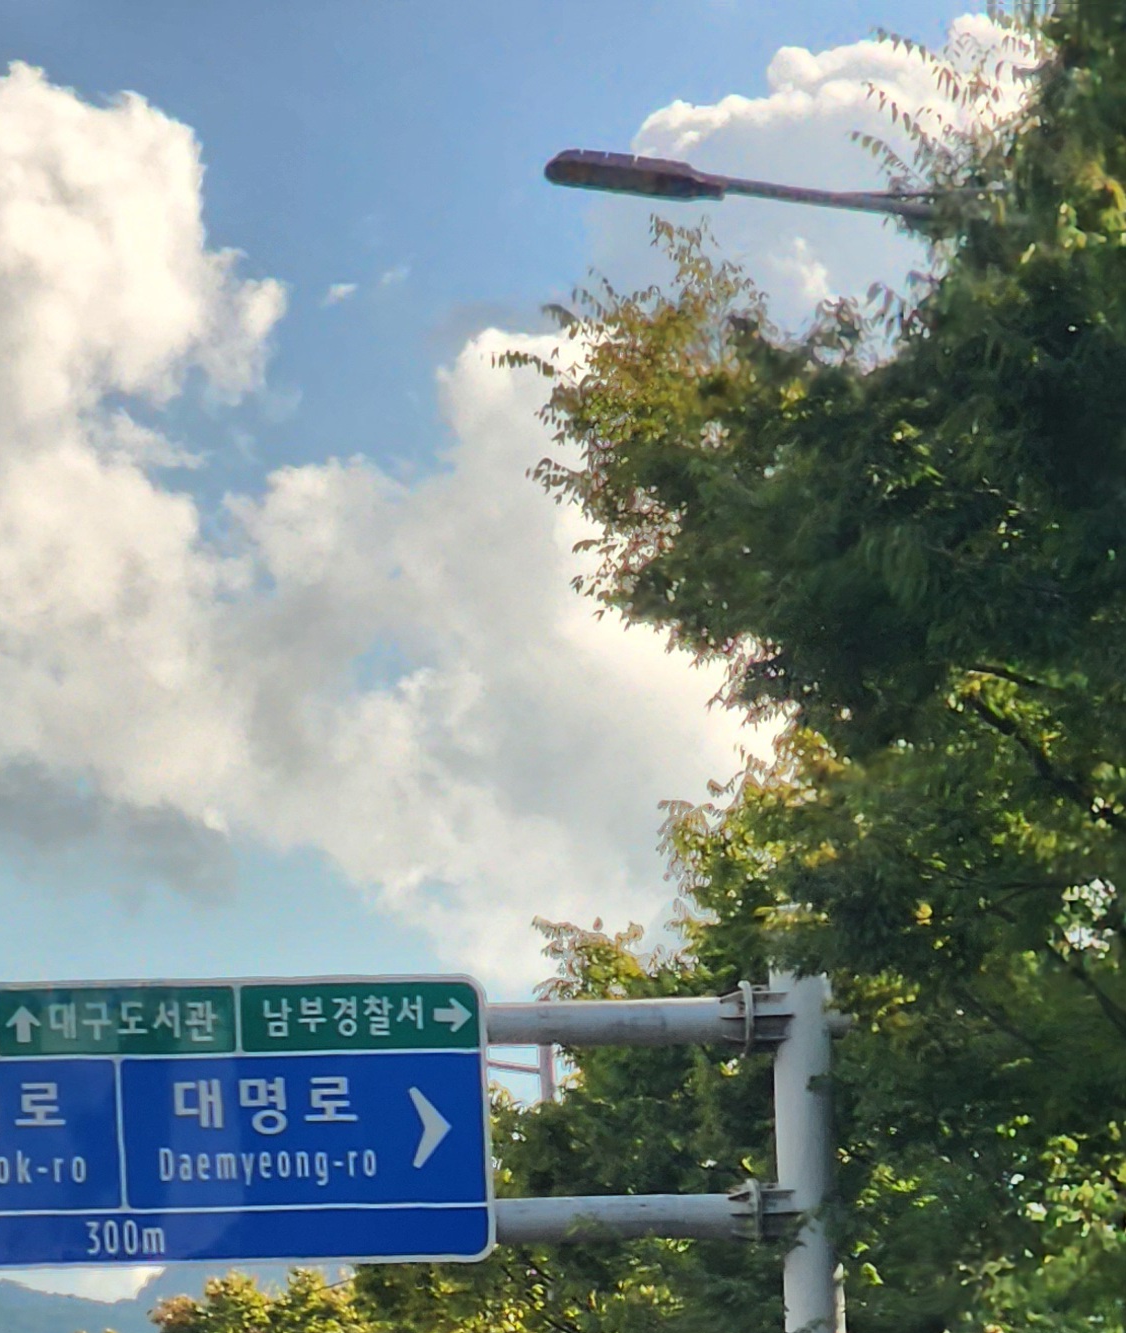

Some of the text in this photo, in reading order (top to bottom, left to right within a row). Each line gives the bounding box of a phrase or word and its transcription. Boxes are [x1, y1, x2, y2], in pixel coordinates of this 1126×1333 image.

[48, 1001, 218, 1042] 대구도서관
[262, 995, 425, 1039] 남부경찰서
[173, 1075, 359, 1135] 대명로
[159, 1147, 377, 1187] Daemyeong-ro
[85, 1219, 166, 1255] 300m
